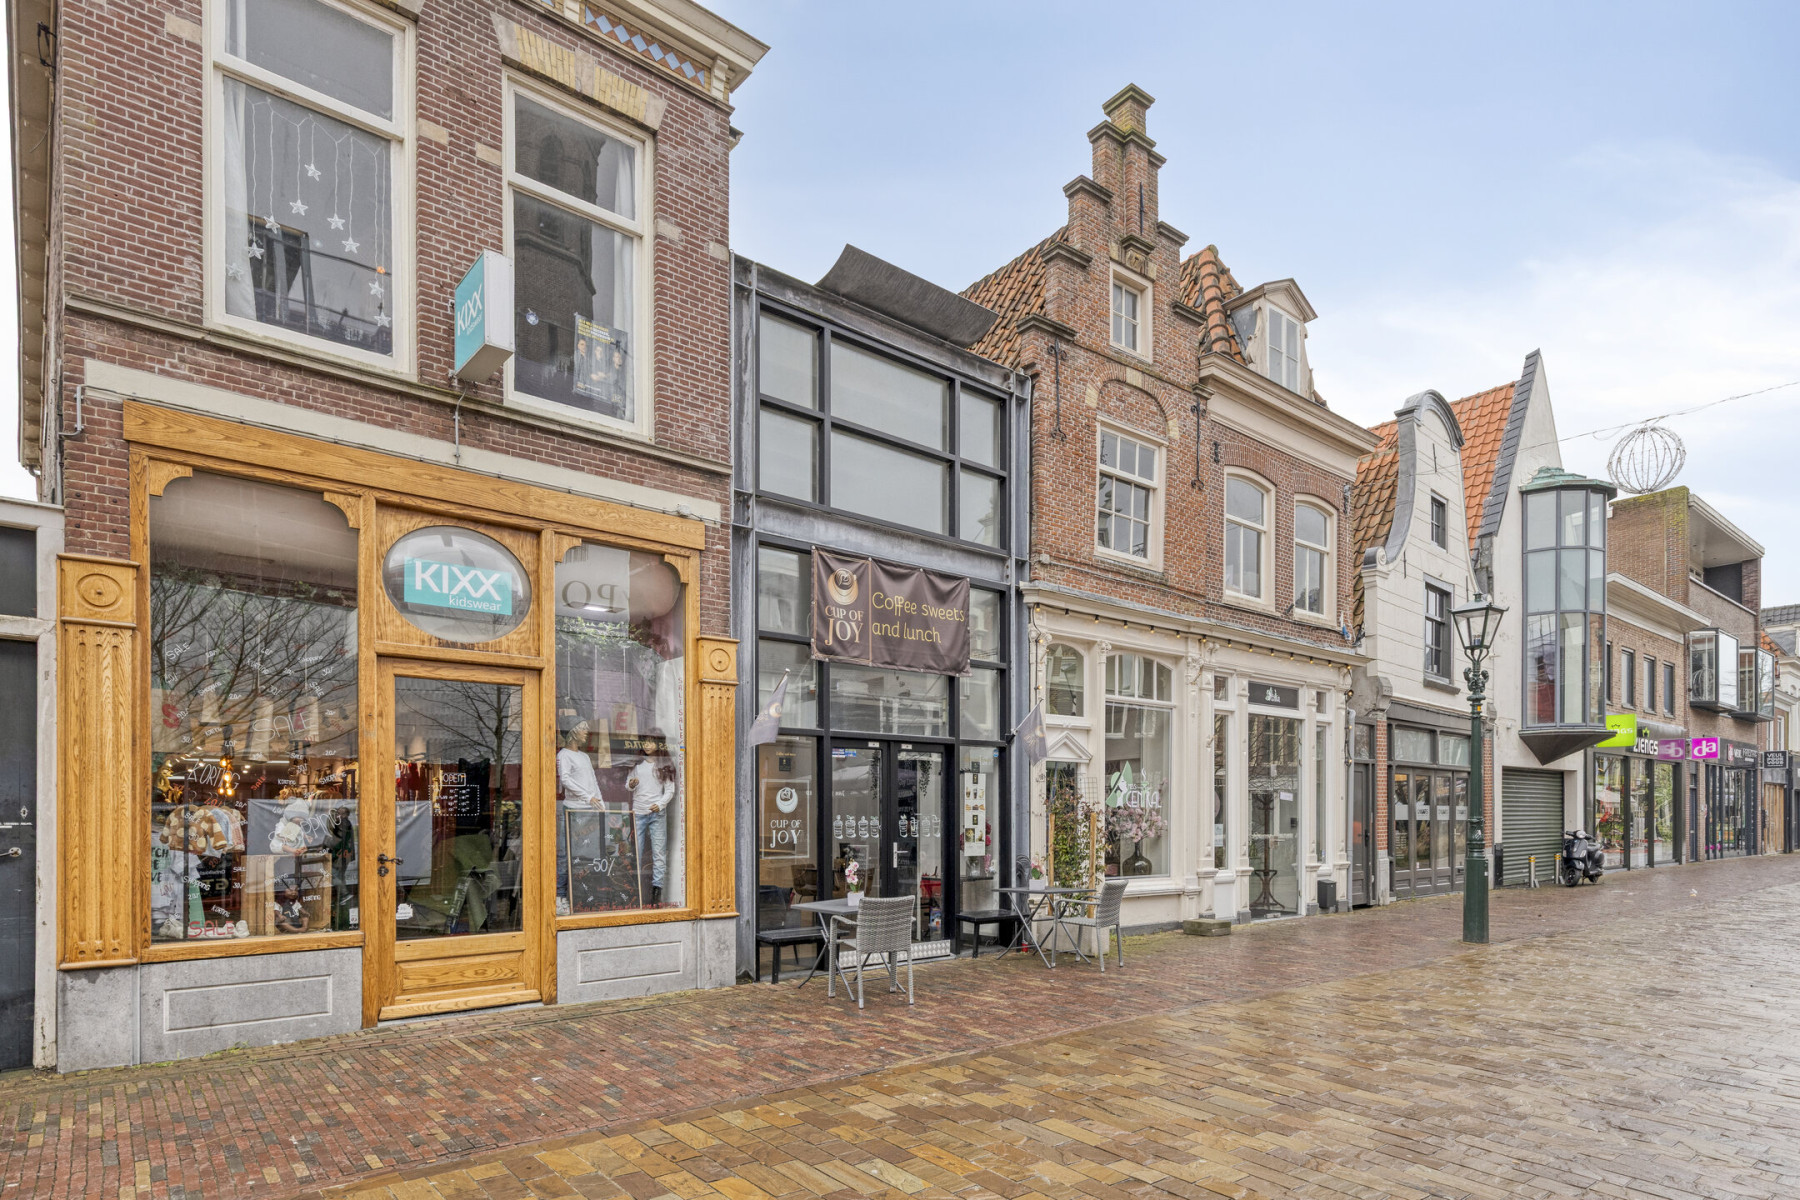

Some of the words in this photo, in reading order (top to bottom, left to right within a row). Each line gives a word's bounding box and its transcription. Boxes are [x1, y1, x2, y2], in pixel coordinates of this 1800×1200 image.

[457, 283, 482, 336] KIXX
[415, 560, 502, 601] KIXX
[449, 594, 502, 611] kidswear
[872, 591, 917, 617] Coffee
[921, 604, 965, 622] sweets
[825, 605, 847, 619] CUP
[849, 610, 864, 621] OF
[824, 618, 864, 646] JOY
[872, 621, 900, 638] and
[903, 622, 941, 644] lunch
[1693, 740, 1717, 757] da
[770, 820, 789, 829] CUP
[790, 820, 802, 828] OF
[769, 829, 802, 848] JOY
[587, 858, 616, 876] -50%
[186, 920, 235, 938] SALE
